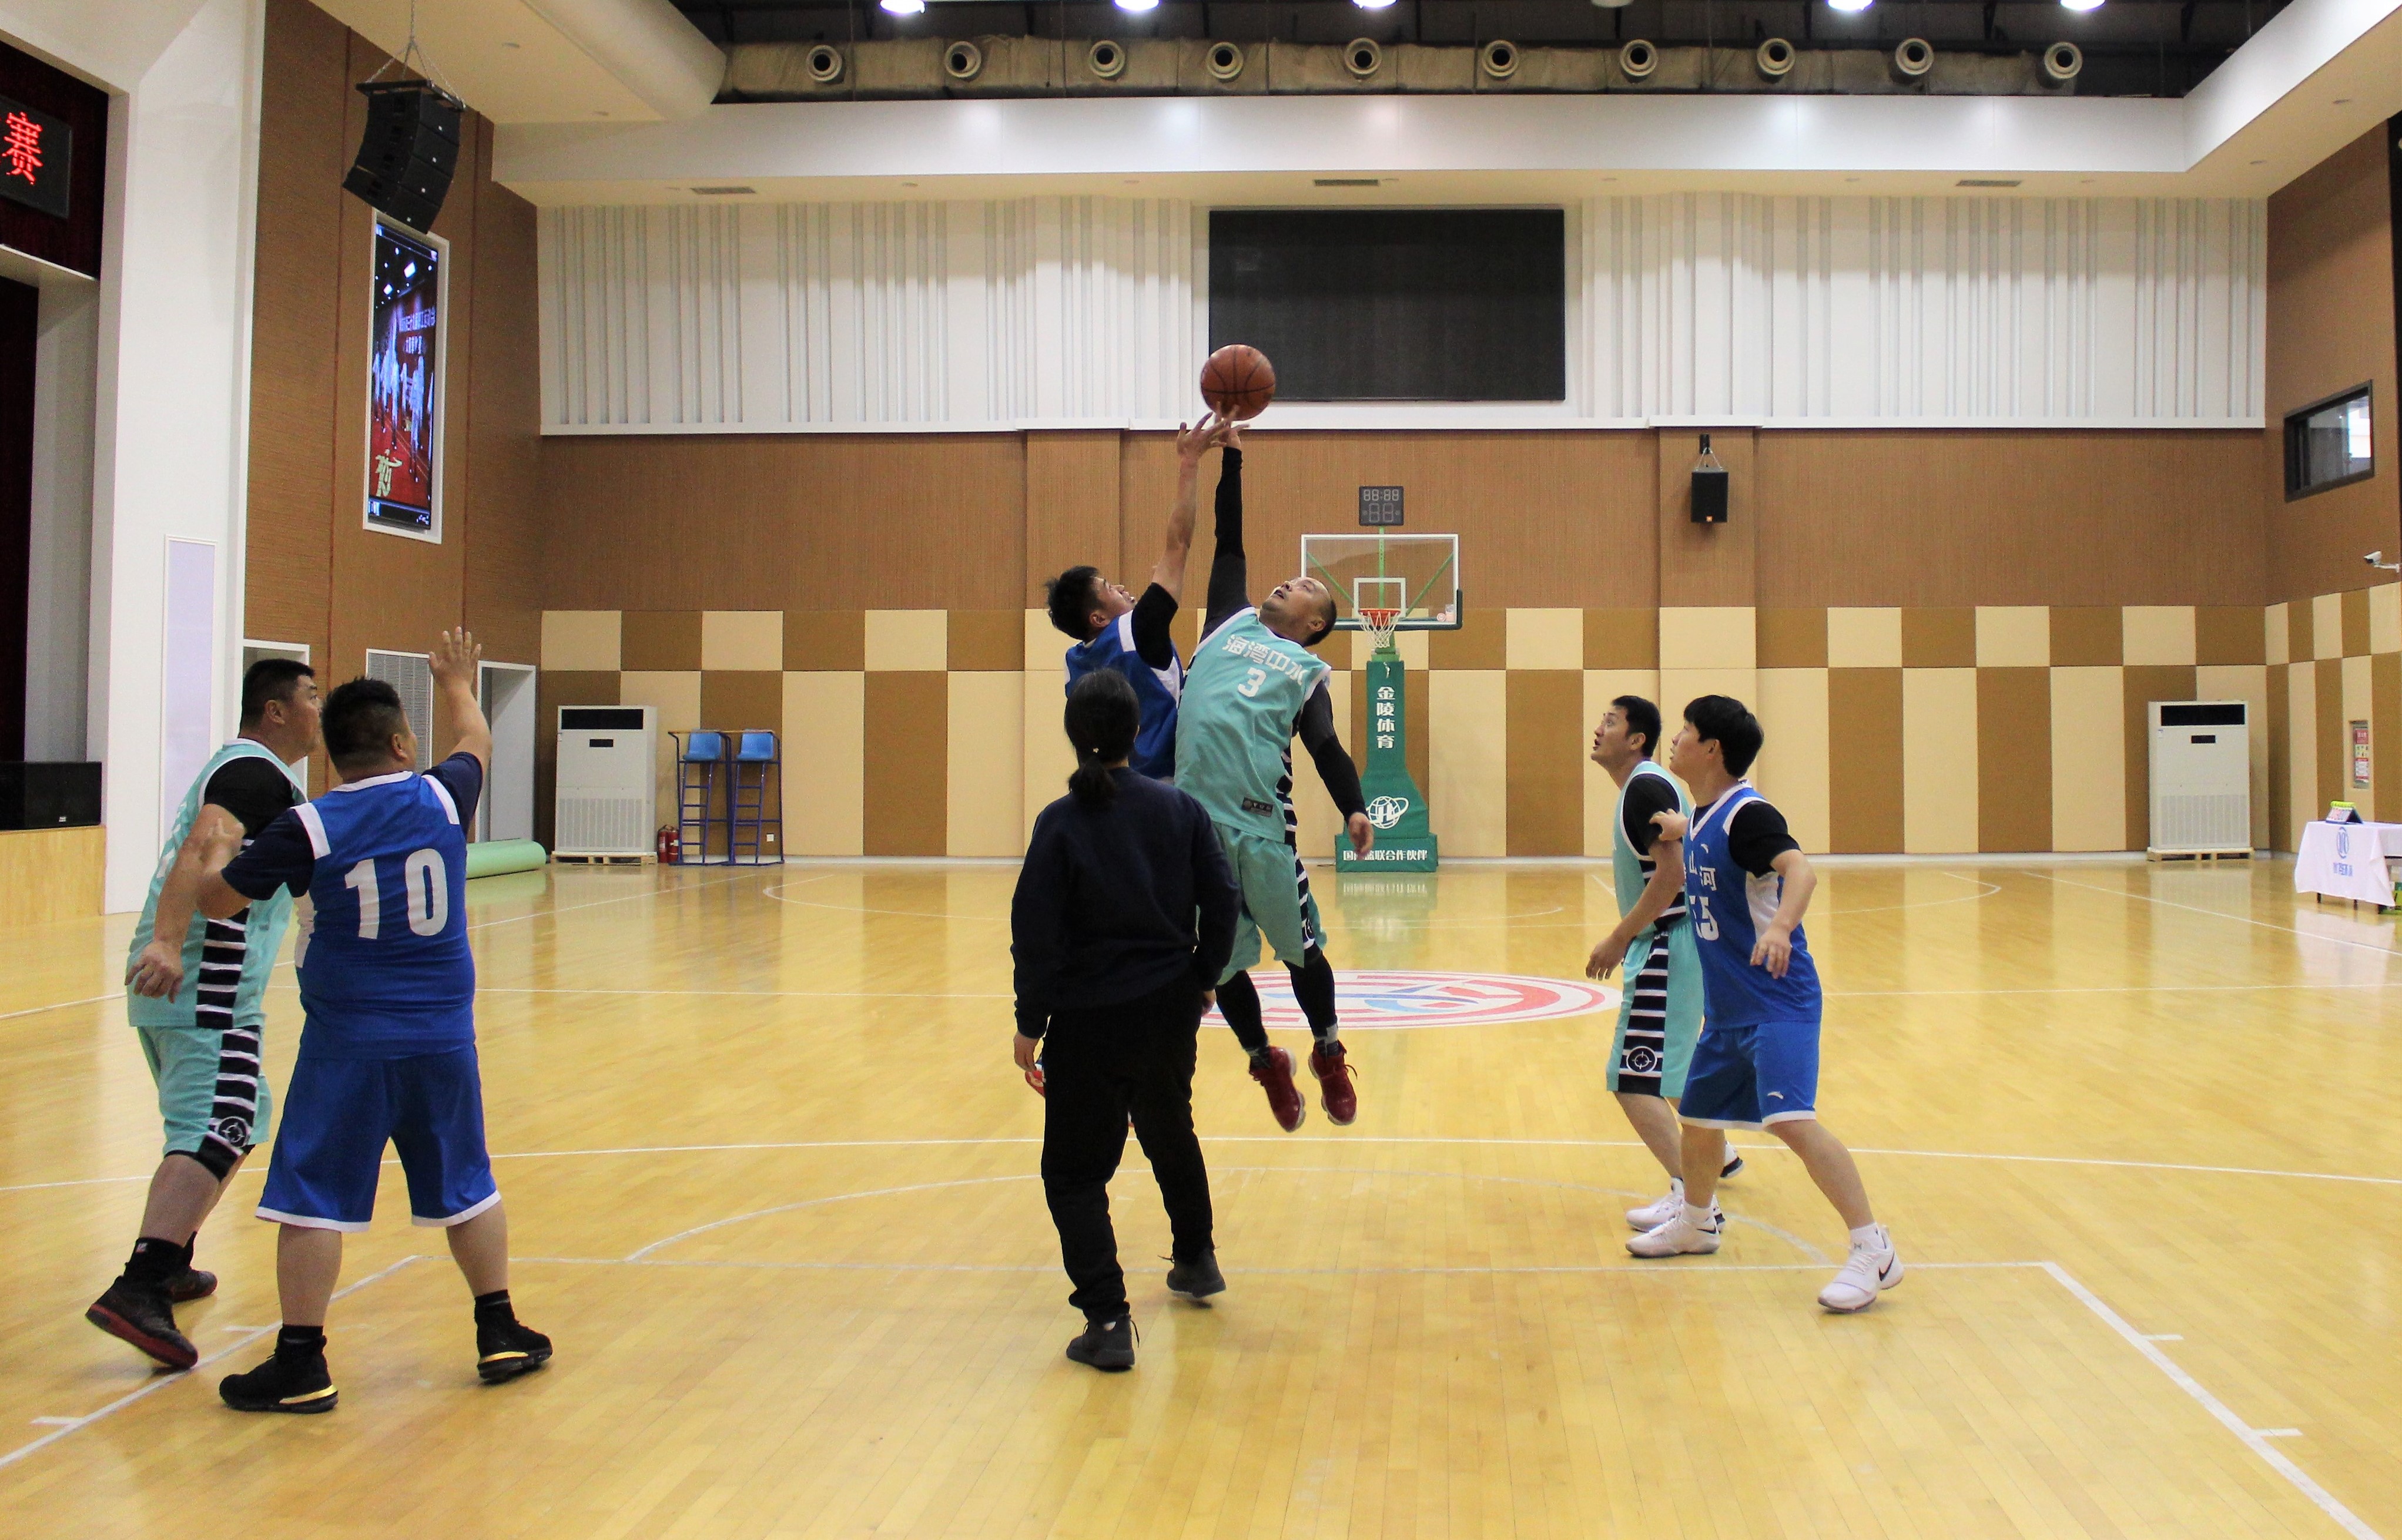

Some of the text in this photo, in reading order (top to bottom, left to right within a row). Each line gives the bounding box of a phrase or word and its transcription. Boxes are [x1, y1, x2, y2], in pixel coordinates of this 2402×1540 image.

[2, 112, 43, 185] 赛
[1222, 634, 1309, 686] 海湾中水
[1238, 667, 1267, 697] 3
[1376, 686, 1396, 749] 金陵体育
[1343, 849, 1428, 861] 国篮联合作伙伴
[1683, 851, 1717, 891] 山河
[344, 848, 448, 940] 10
